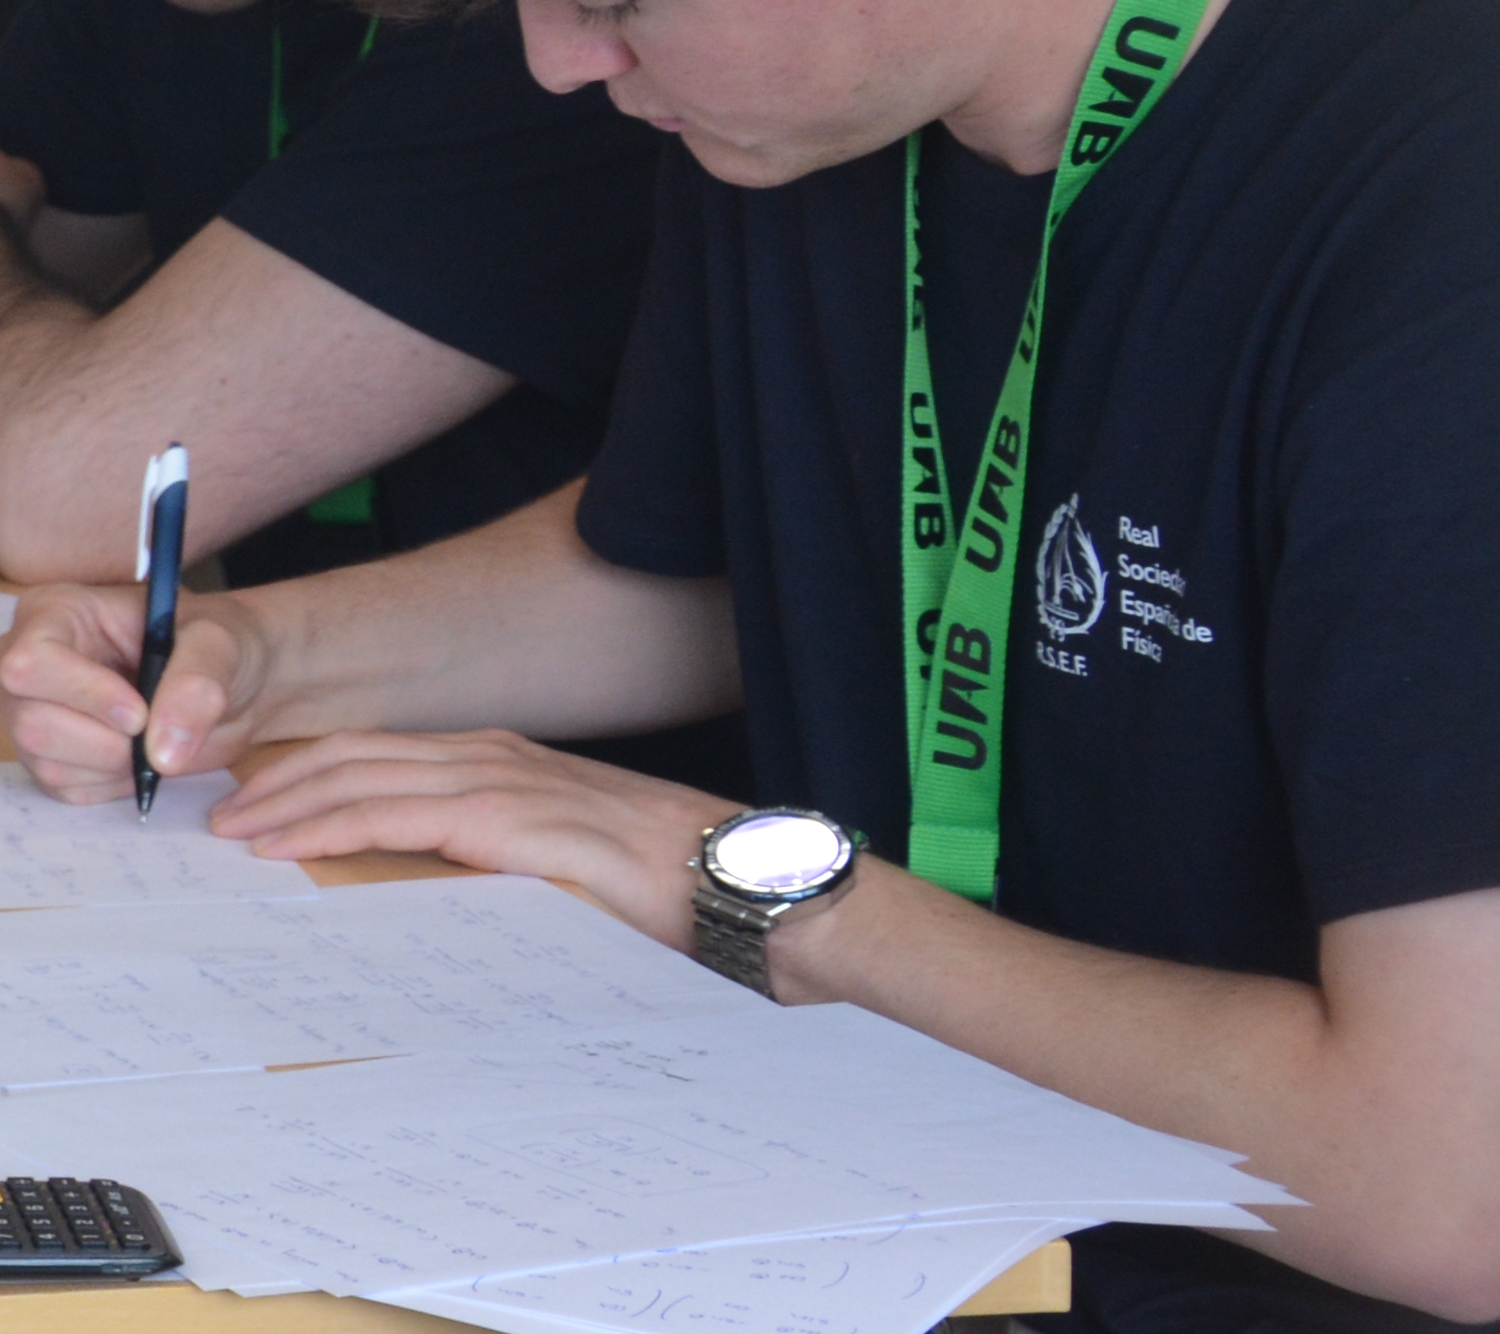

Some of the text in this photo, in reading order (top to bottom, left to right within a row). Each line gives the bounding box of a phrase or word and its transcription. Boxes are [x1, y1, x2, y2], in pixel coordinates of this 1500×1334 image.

[1070, 14, 1182, 169] UAB
[910, 392, 946, 551] UAB
[965, 413, 1023, 573] UAB
[1118, 516, 1160, 548] Real
[1117, 553, 1187, 597] Socied
[1182, 619, 1213, 643] de
[933, 620, 994, 773] UAB
